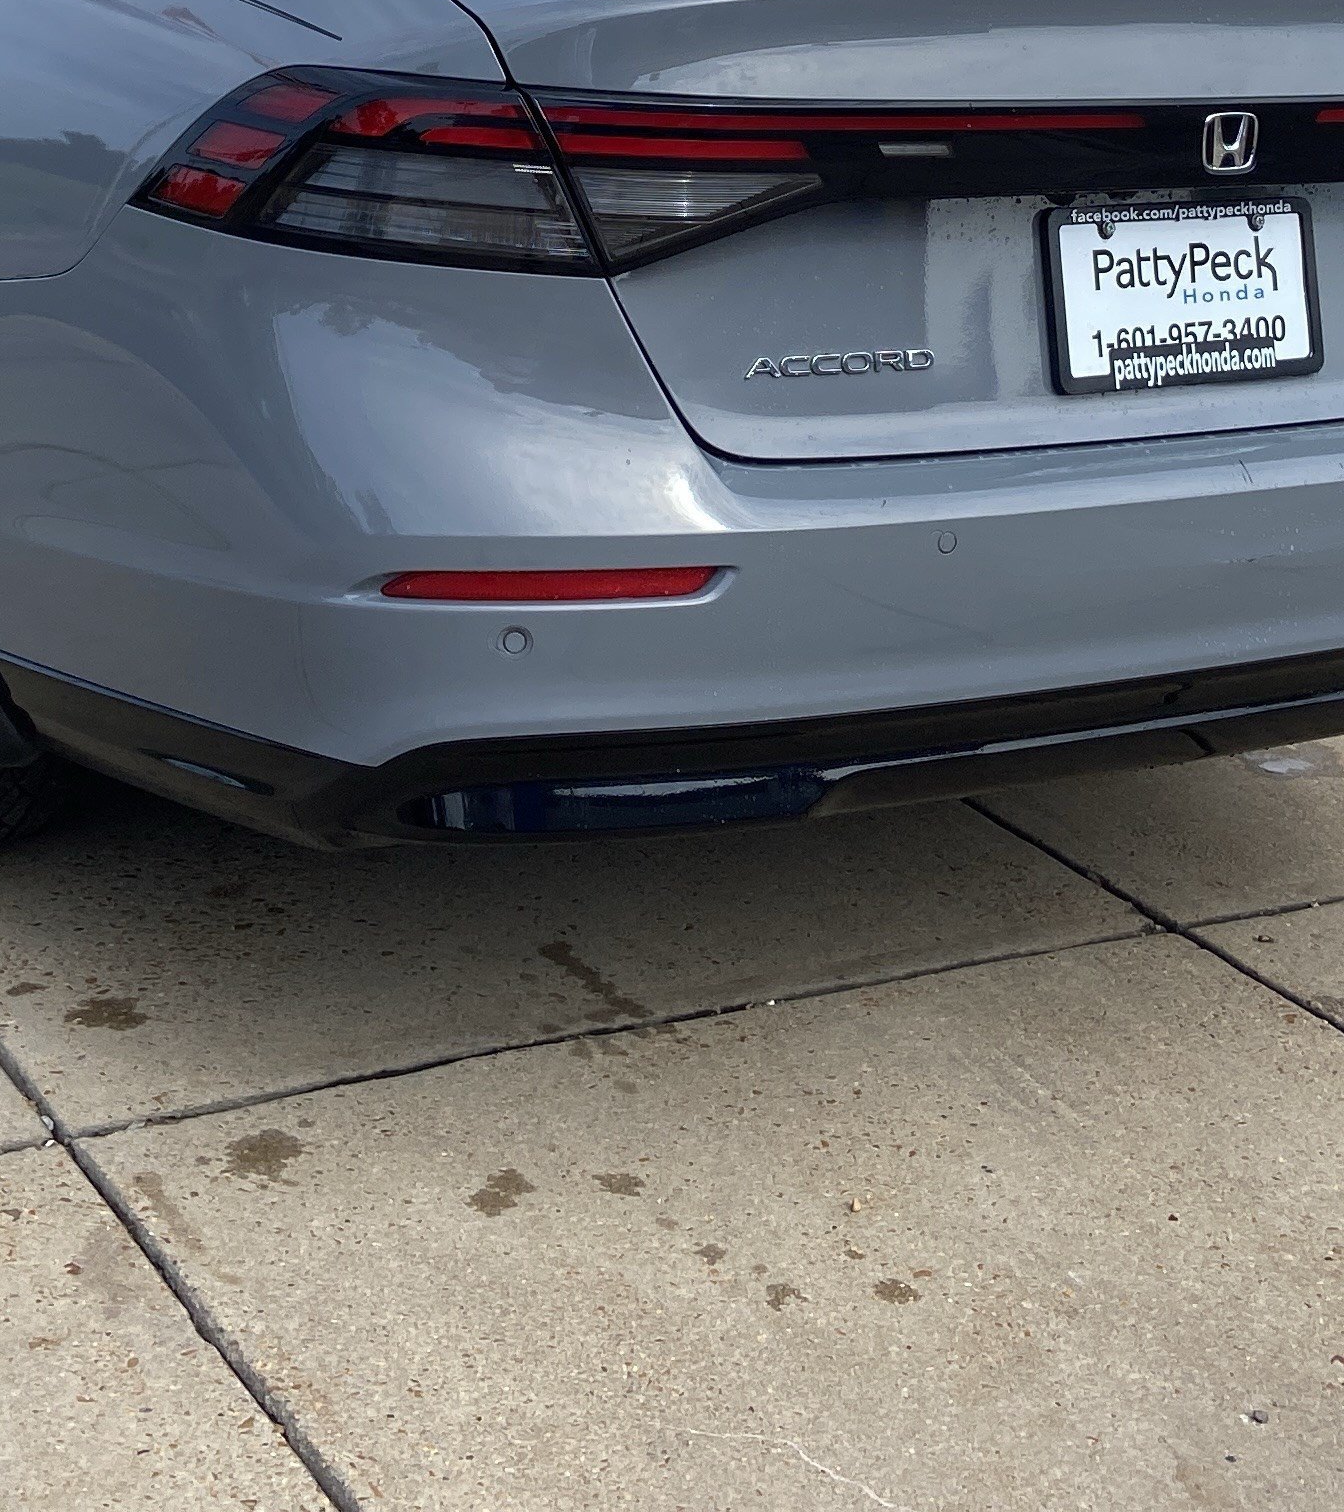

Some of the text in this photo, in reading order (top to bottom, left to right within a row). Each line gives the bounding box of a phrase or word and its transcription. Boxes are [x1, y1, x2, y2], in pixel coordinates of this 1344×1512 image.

[1071, 200, 1292, 223] facebook.com/pattypeckhonda
[1092, 235, 1279, 299] PattyPeck
[1183, 284, 1265, 305] Honda
[1091, 314, 1286, 358] 1-601-957-3400
[744, 349, 935, 380] ACCORD
[1113, 342, 1276, 389] pattypeckhonda.com
